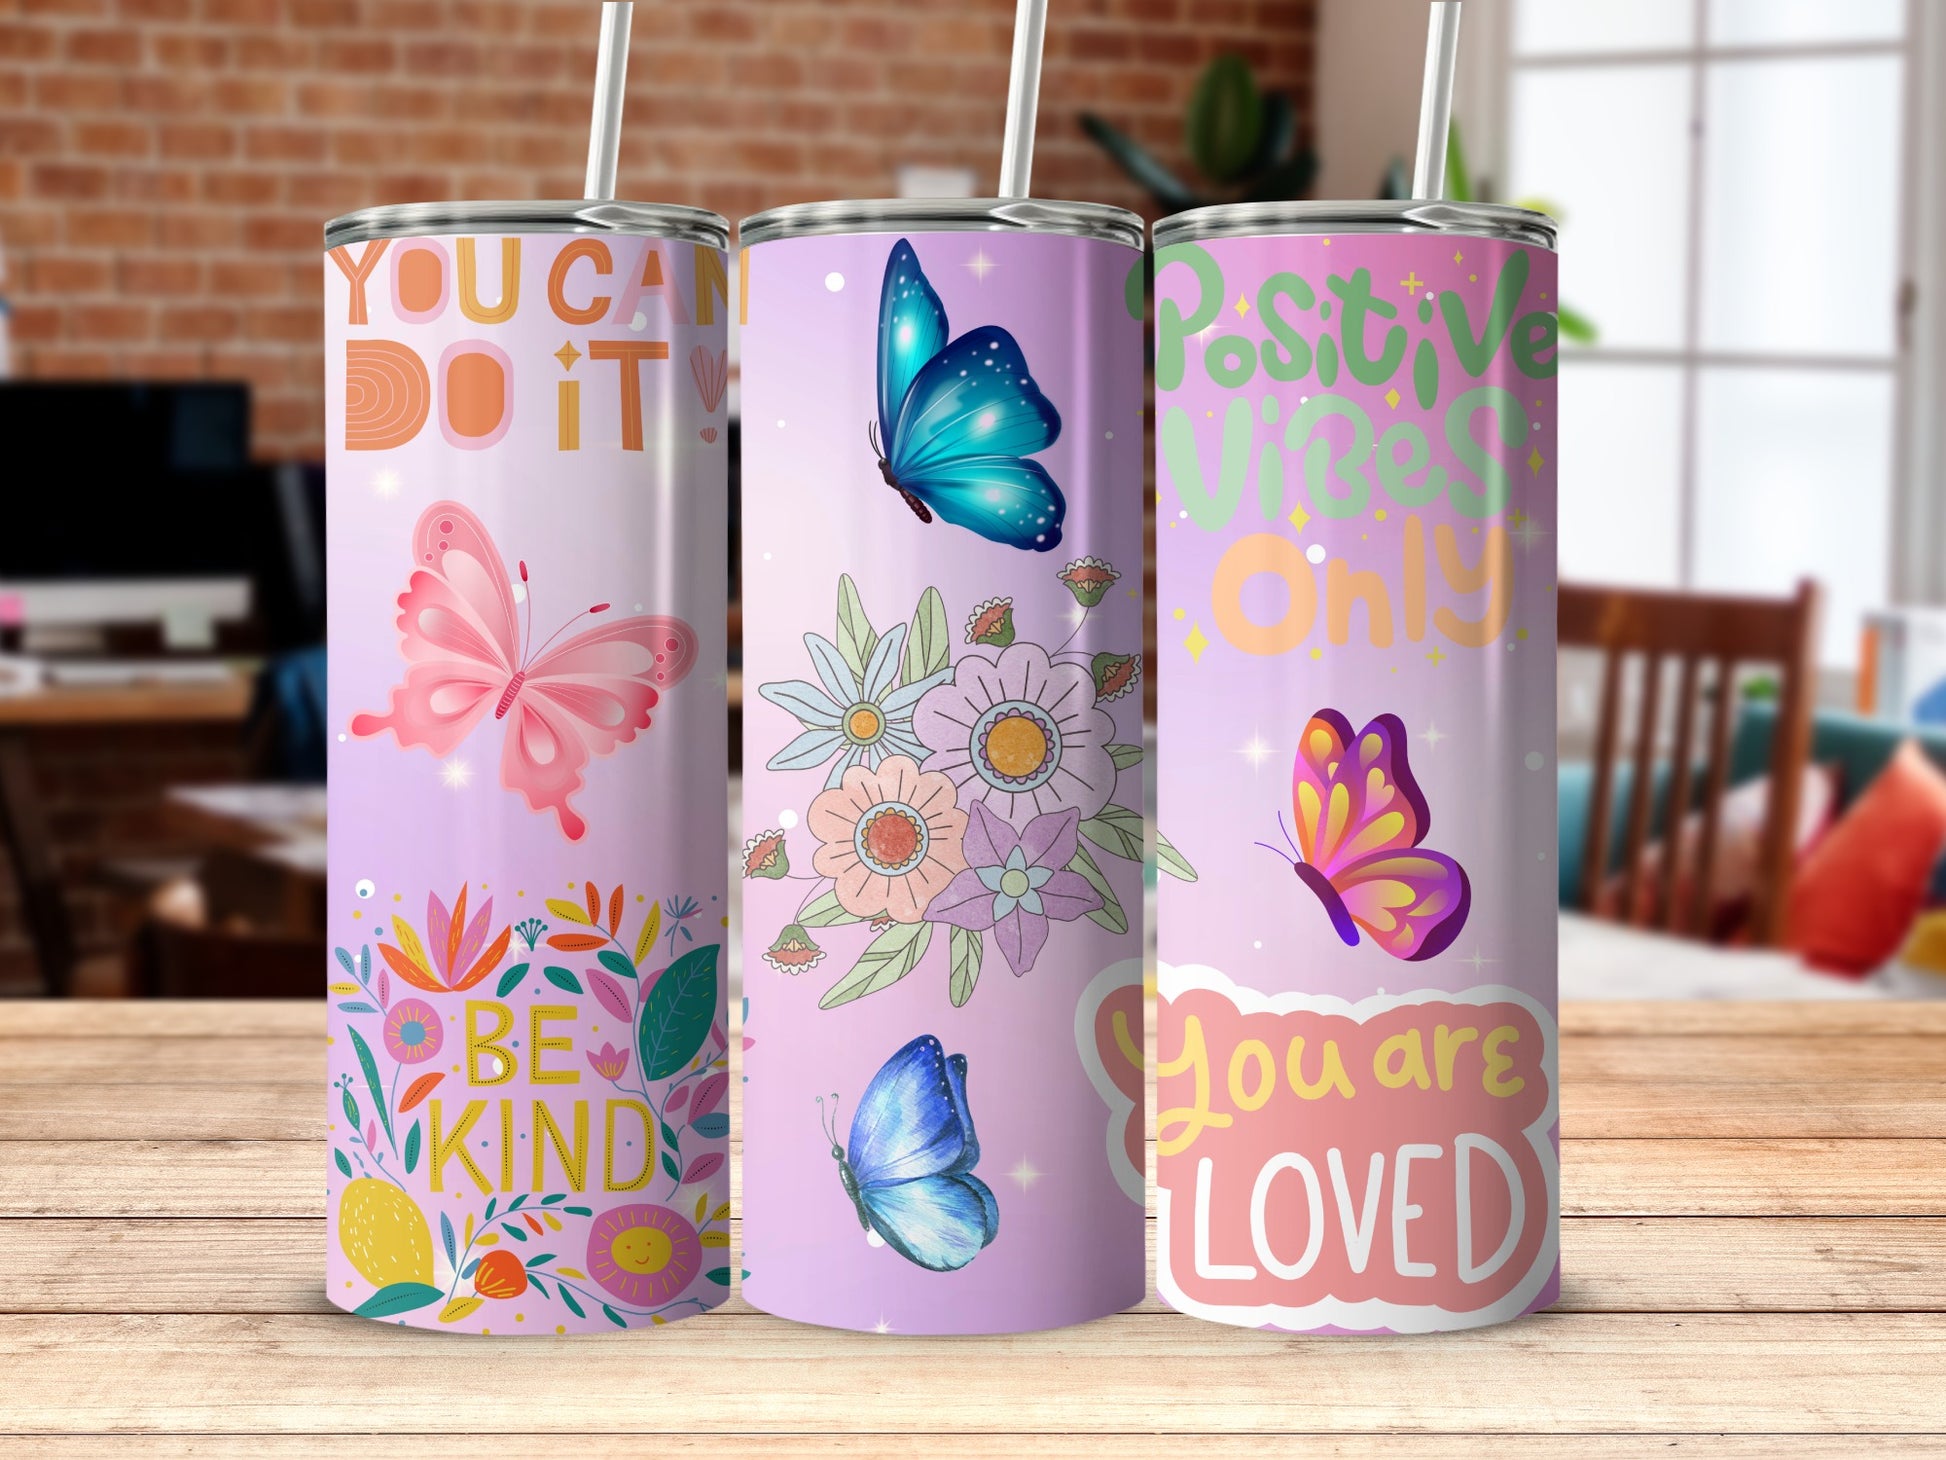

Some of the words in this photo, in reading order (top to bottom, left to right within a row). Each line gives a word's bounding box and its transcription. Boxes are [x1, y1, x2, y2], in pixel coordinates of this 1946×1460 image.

[327, 237, 522, 325] YOU
[344, 338, 515, 451] DO
[1211, 514, 1515, 656] Only
[464, 999, 581, 1087] BE
[1372, 1023, 1526, 1099] are
[428, 1098, 656, 1197] KIND
[1194, 1132, 1526, 1285] LOVED
